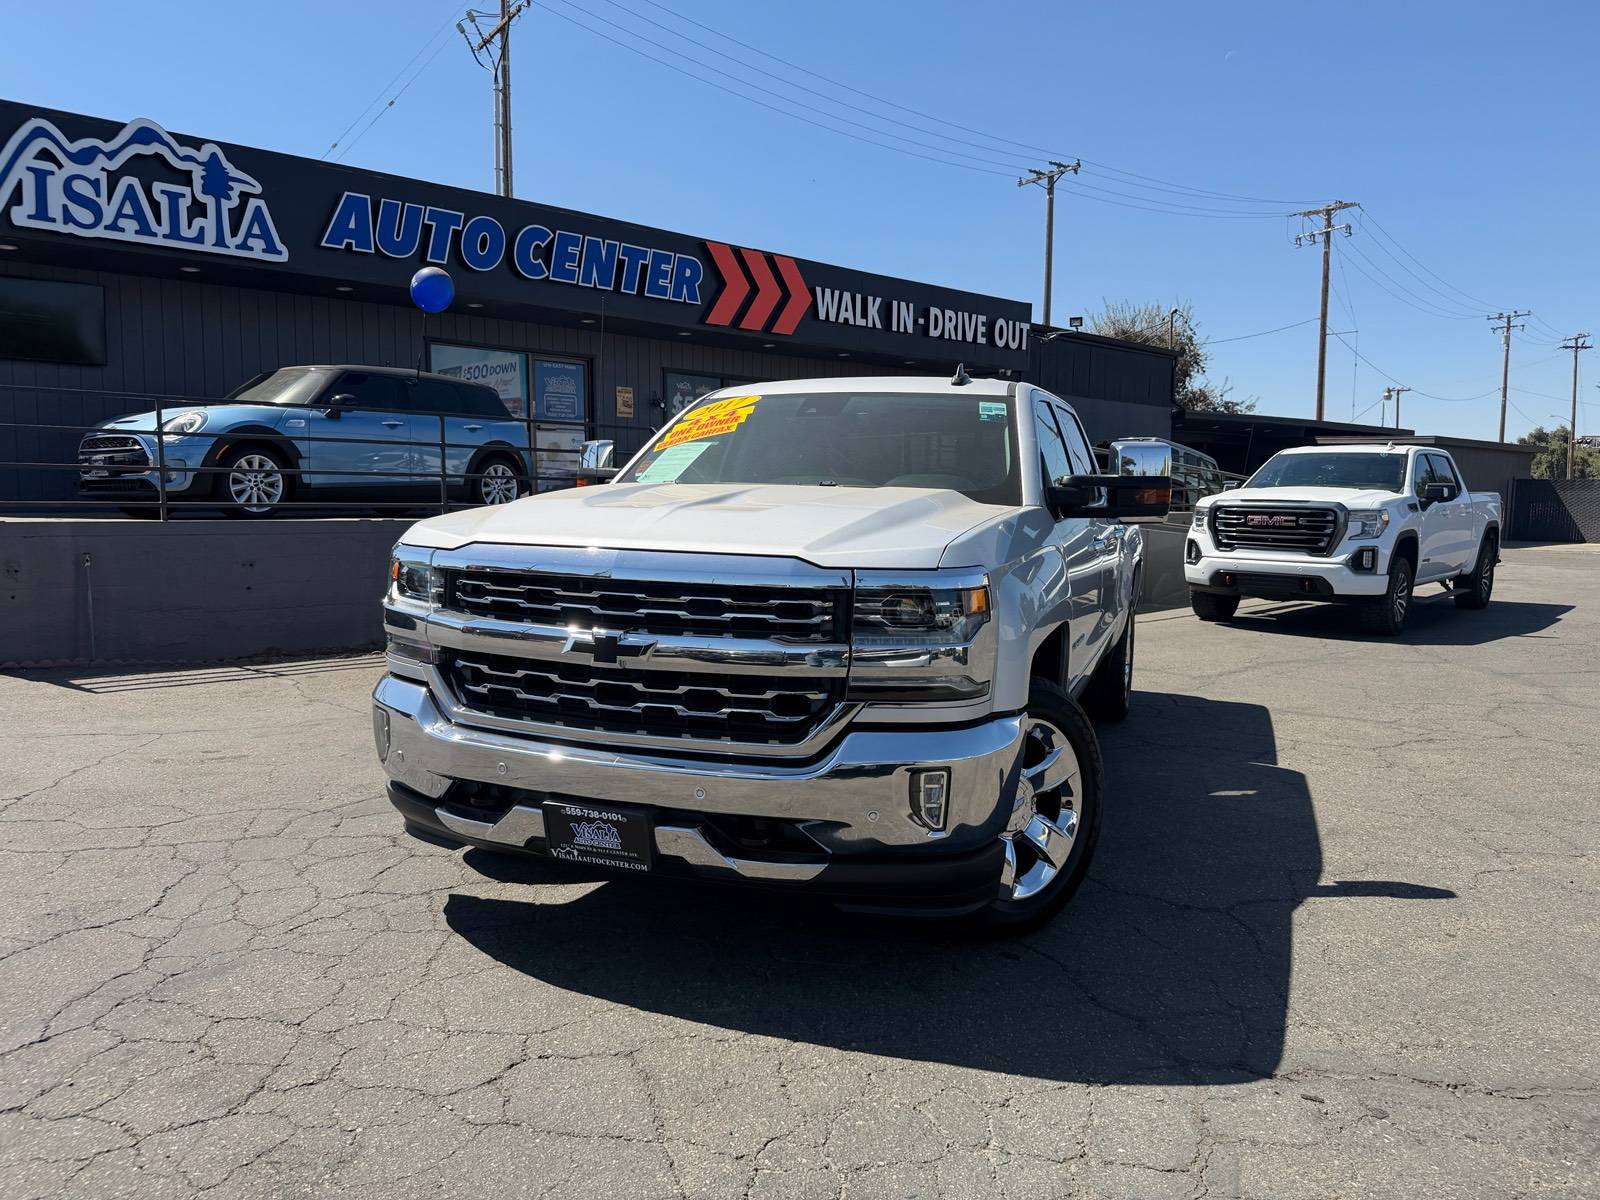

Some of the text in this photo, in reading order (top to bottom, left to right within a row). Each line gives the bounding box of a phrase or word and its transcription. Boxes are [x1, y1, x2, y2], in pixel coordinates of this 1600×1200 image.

[320, 191, 704, 305] AUTO CENTER
[815, 286, 882, 329] WALK
[994, 317, 1031, 350] OUT
[489, 361, 517, 376] DOWN
[695, 415, 741, 431] OWNER
[1246, 514, 1296, 527] GMC
[565, 806, 622, 821] 559-738-0101
[570, 821, 621, 843] VISALIA
